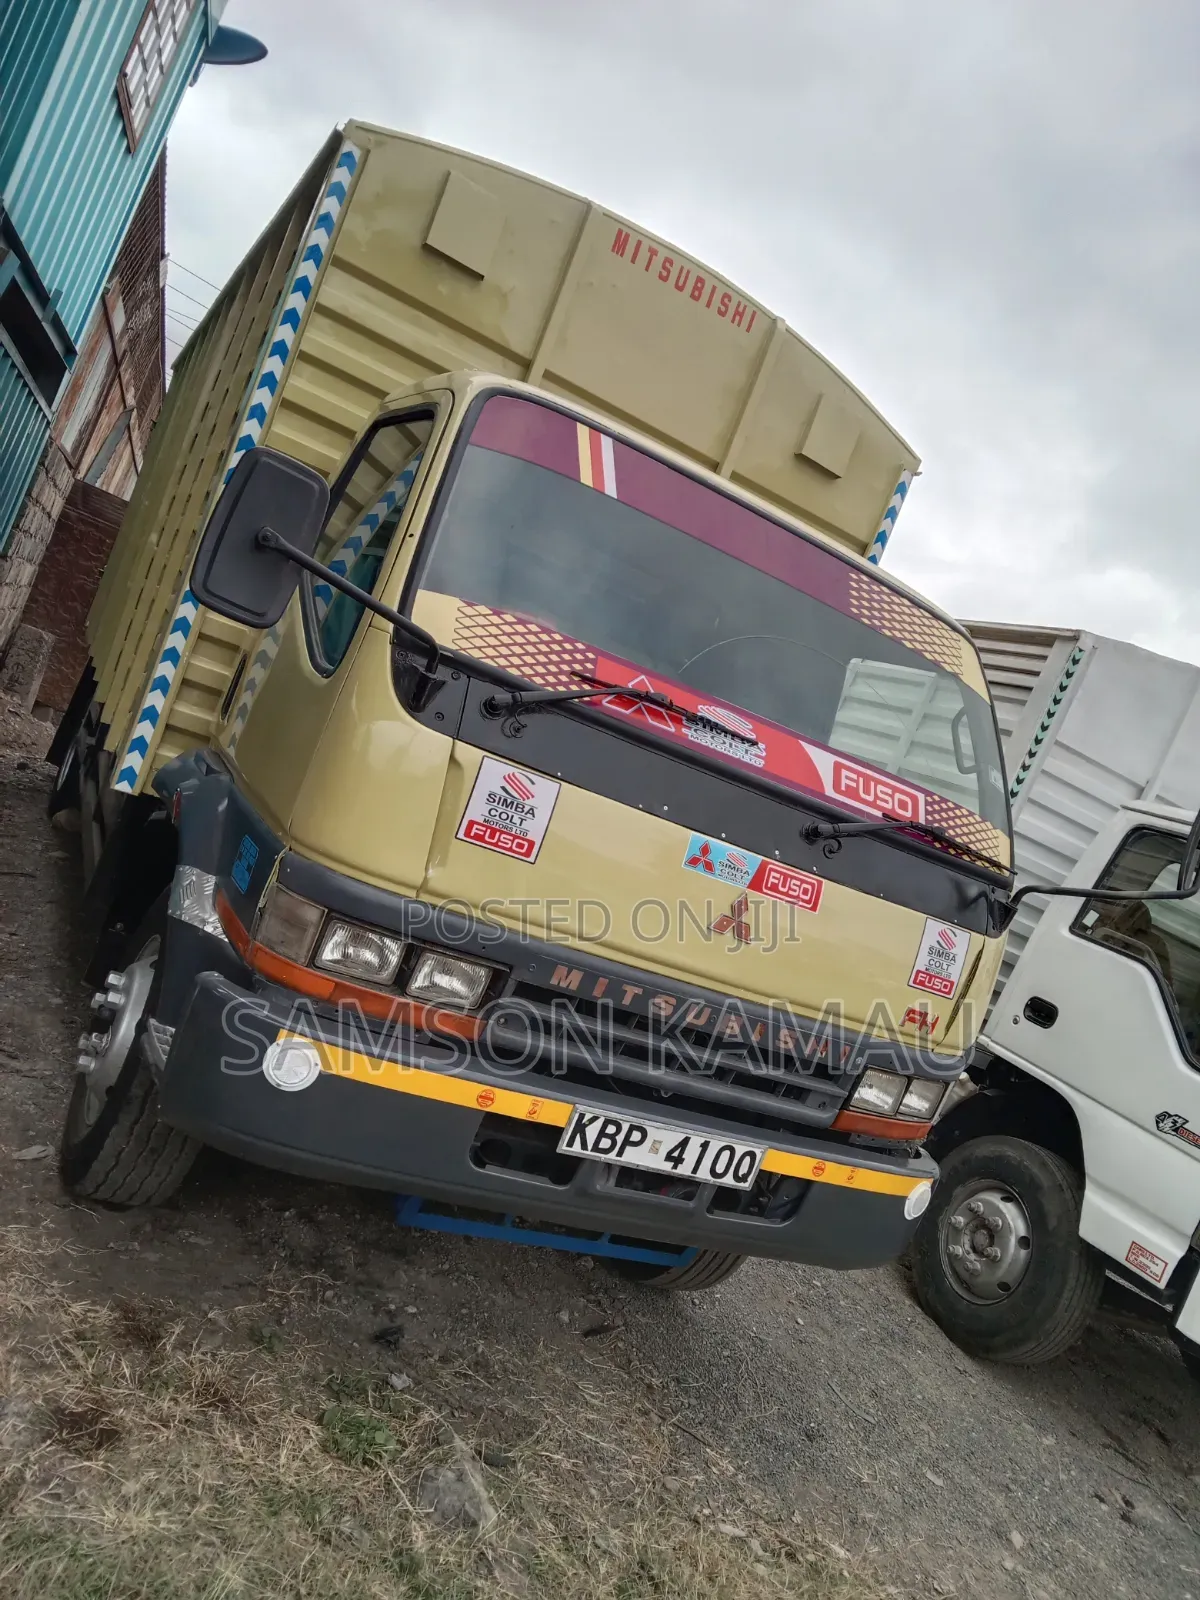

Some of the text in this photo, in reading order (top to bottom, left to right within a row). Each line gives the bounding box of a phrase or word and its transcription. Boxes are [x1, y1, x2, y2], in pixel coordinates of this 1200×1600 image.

[611, 228, 757, 333] MITSUBISHI
[840, 768, 913, 818] FUSO
[486, 792, 536, 818] SIMBA
[483, 817, 528, 838] MOTORS LTD
[488, 807, 527, 827] COLT
[470, 824, 528, 853] FUSO
[718, 860, 750, 877] SIMBA
[720, 868, 745, 880] COLT
[767, 871, 813, 900] FUSO
[927, 945, 957, 964] SIMBA
[928, 958, 951, 972] COLT
[916, 972, 951, 992] FUSO
[549, 964, 852, 1064] MITSUBISHI
[565, 1112, 757, 1185] KBP 410Q
